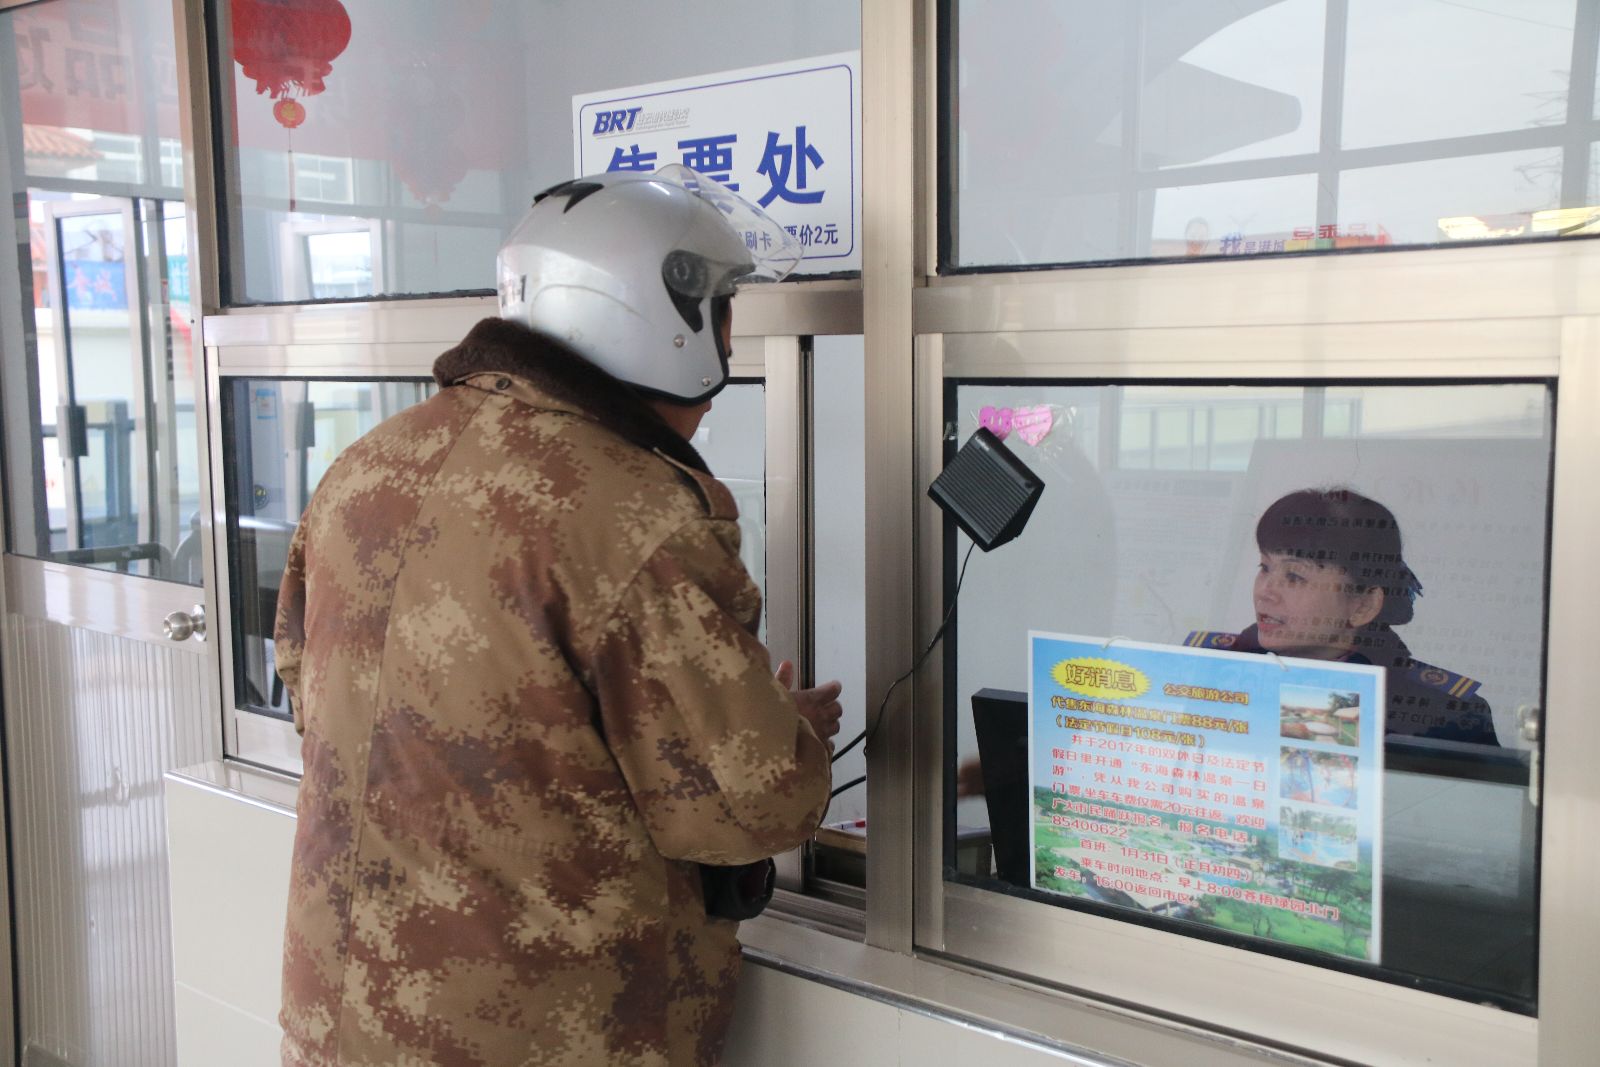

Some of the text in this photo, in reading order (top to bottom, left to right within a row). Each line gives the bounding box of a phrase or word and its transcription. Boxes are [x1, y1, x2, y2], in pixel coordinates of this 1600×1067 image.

[592, 107, 642, 135] BRT
[738, 230, 772, 251] 刷卡
[1065, 663, 1136, 692] 好消息
[1163, 683, 1249, 706] 公交旅游公司
[1052, 816, 1128, 839] 85400622
